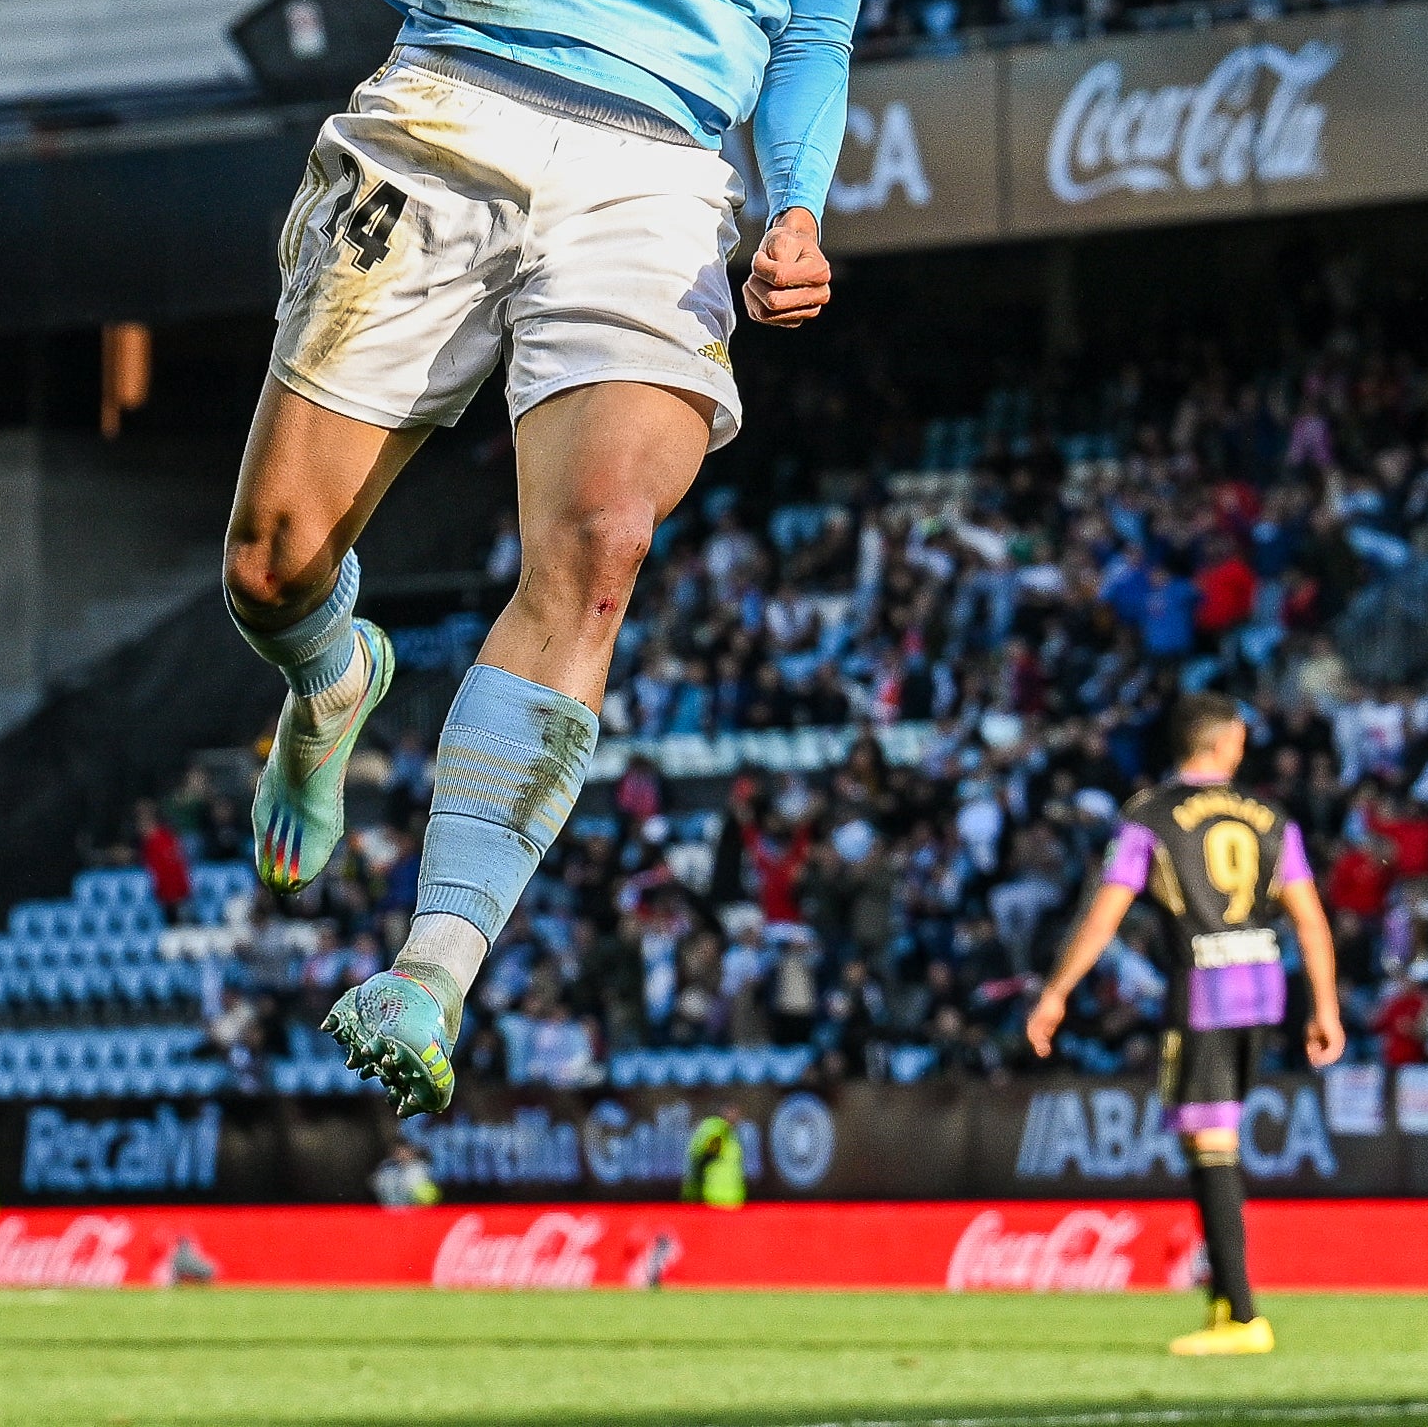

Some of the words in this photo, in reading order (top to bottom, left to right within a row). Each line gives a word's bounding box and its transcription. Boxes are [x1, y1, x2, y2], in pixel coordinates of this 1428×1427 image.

[1049, 41, 1342, 203] Coca-Cola
[1202, 820, 1260, 925] 9
[1035, 1086, 1338, 1181] ABACA
